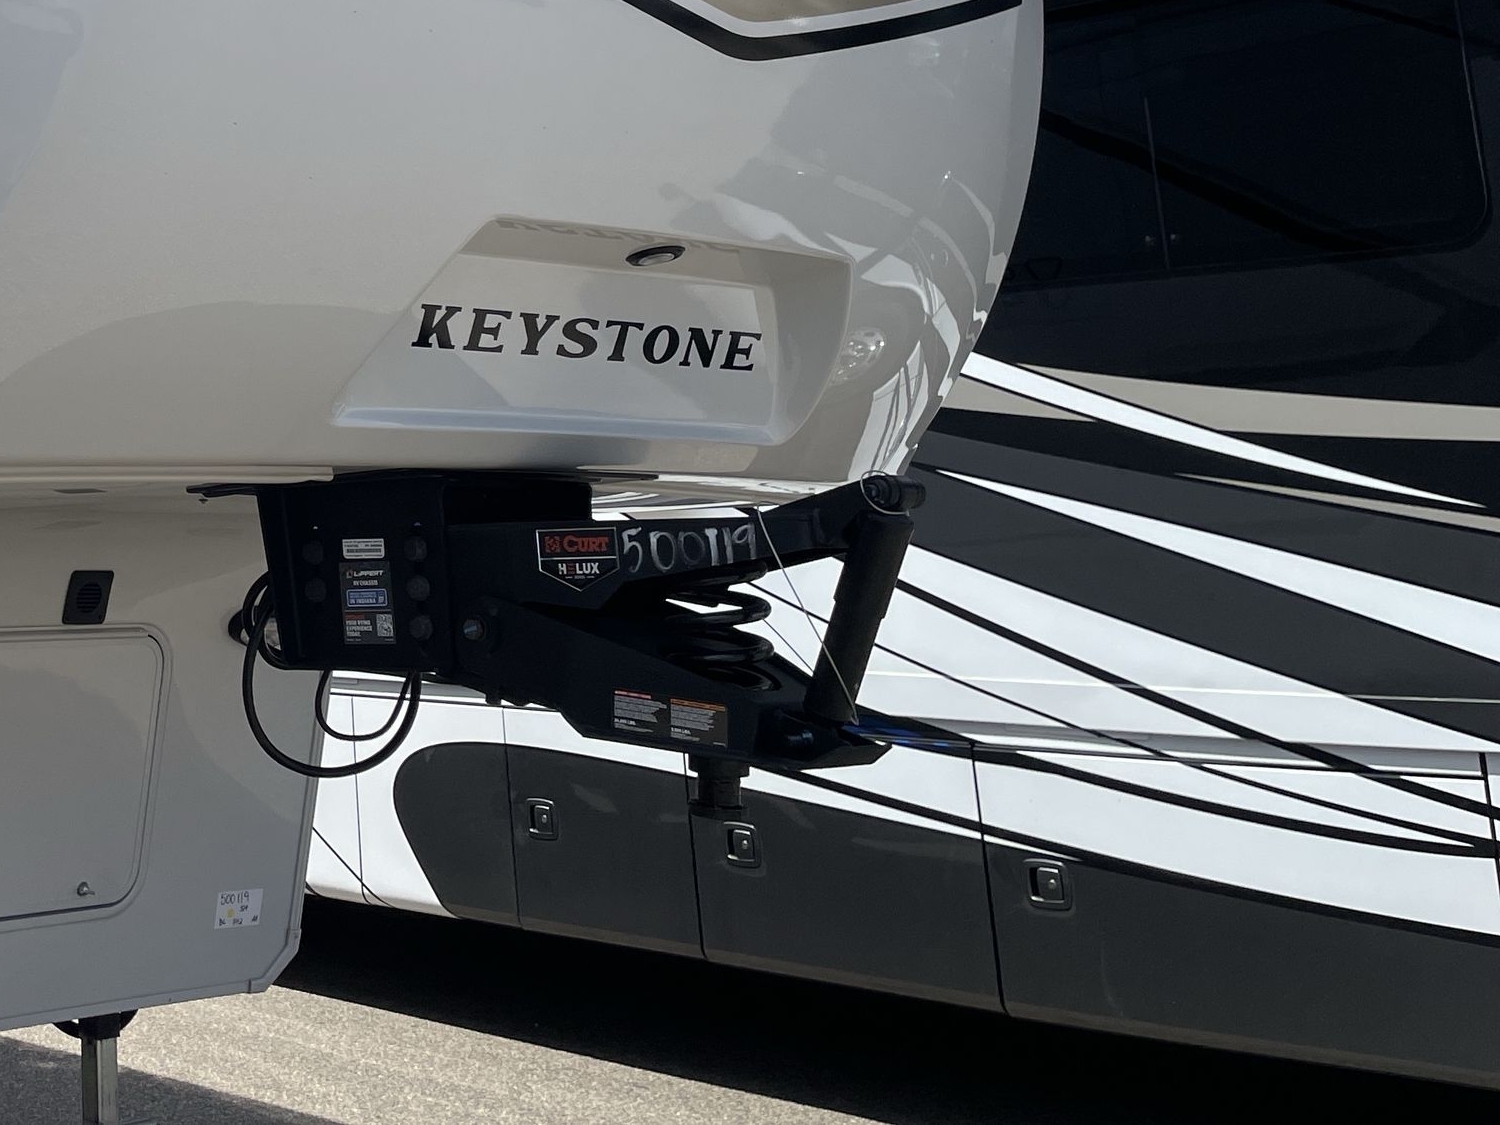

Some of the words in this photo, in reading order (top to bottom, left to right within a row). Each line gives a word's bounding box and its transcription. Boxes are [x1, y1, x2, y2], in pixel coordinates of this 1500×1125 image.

[411, 302, 763, 372] KEYSTONE
[621, 522, 757, 573] 500119
[558, 562, 600, 575] HELUX
[220, 890, 250, 906] 500119
